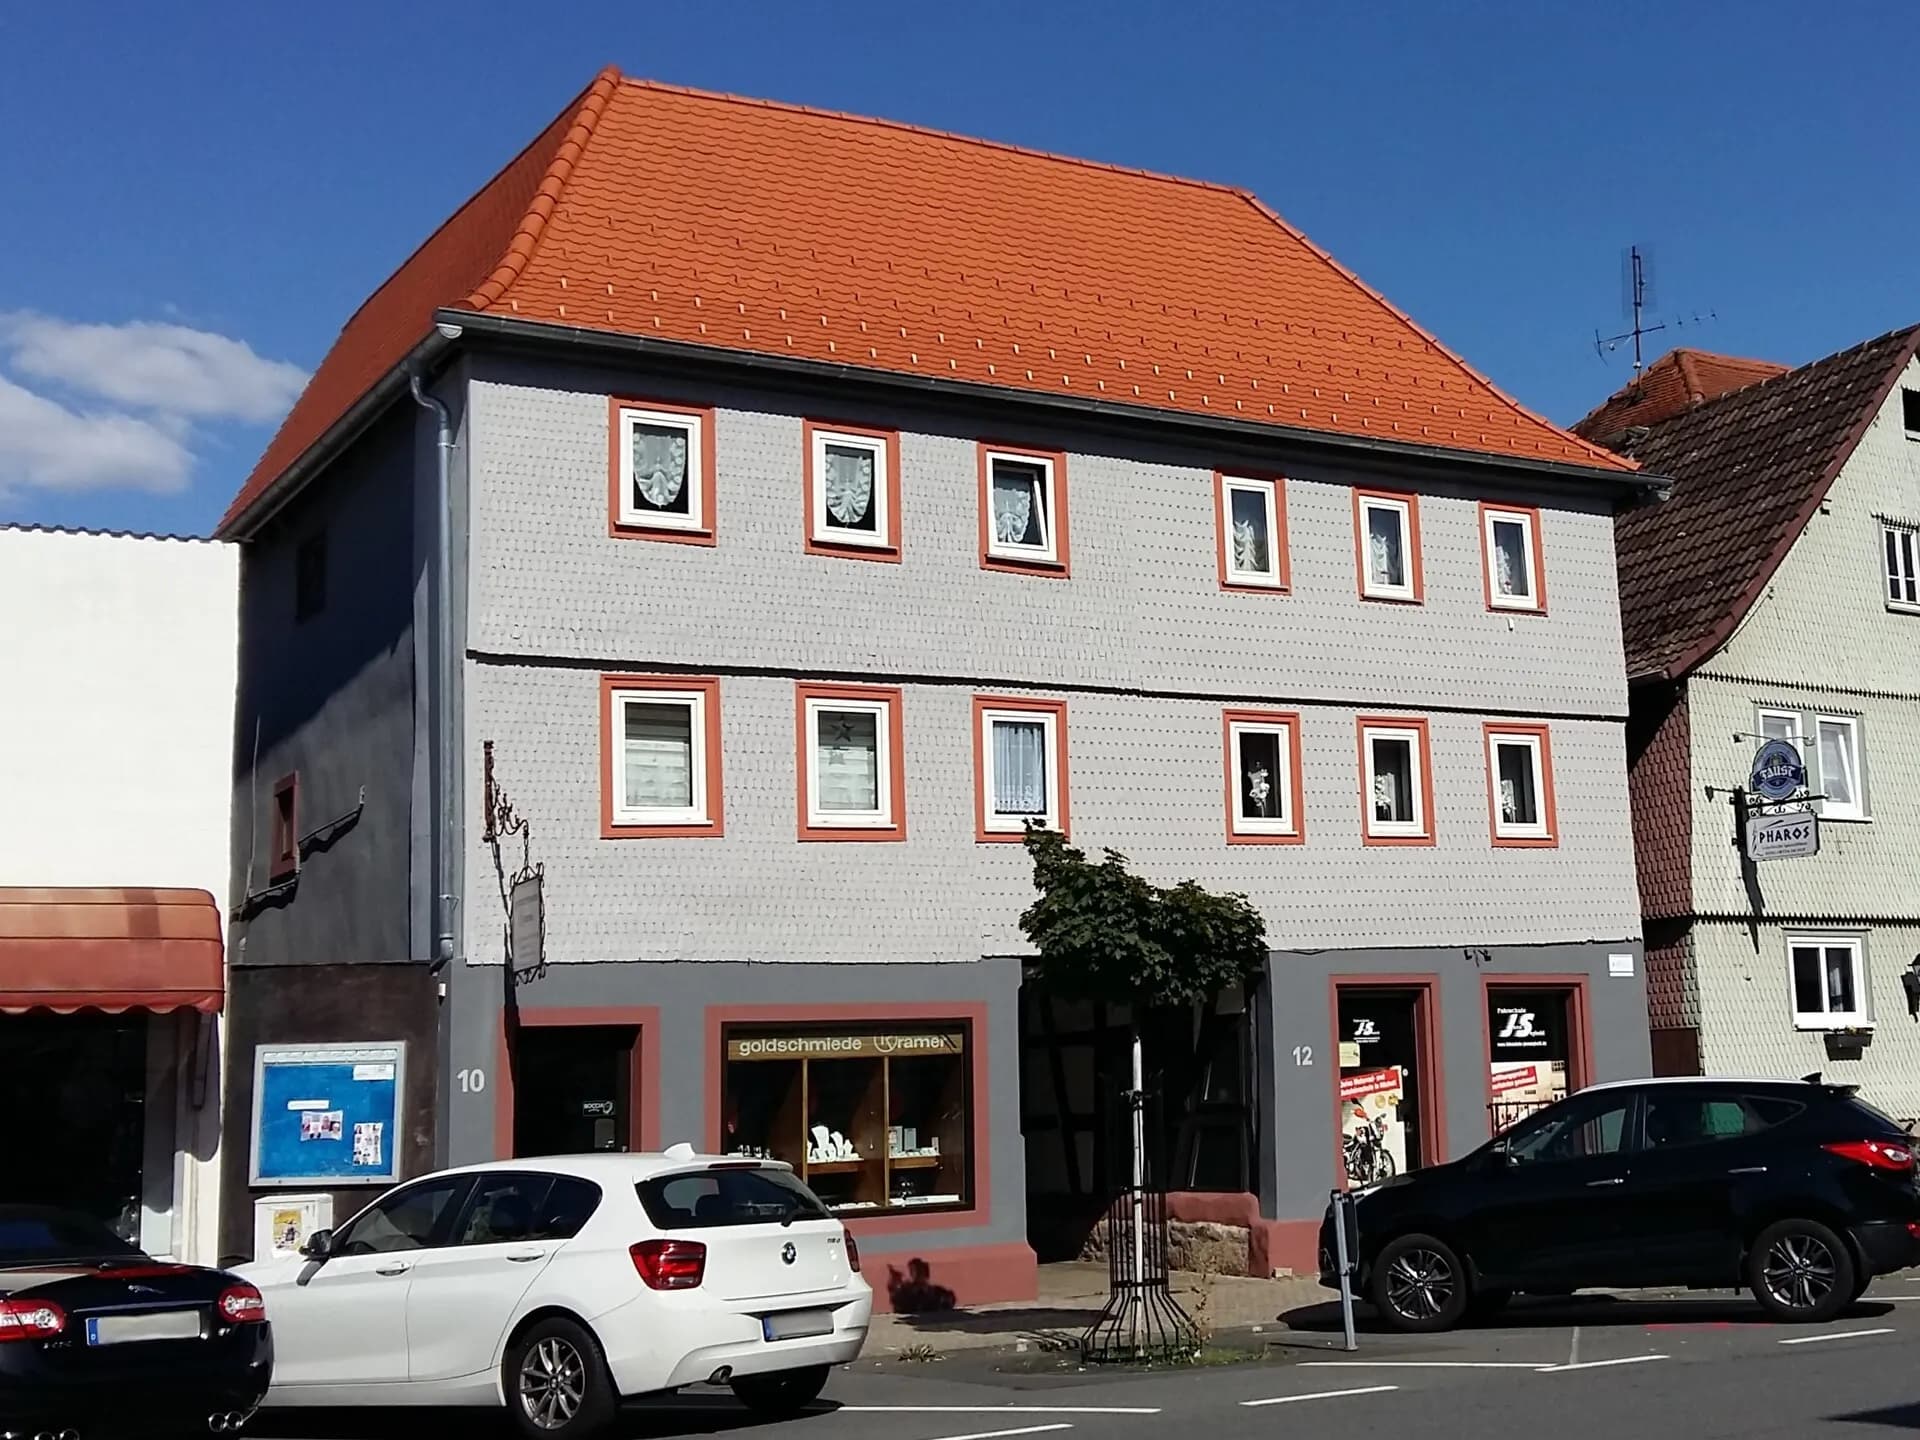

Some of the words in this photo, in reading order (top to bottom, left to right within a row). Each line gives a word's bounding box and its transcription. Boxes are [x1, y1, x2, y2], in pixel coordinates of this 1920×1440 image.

[1760, 765, 1796, 780] FAUST
[1759, 826, 1809, 843] PHAROS
[739, 1037, 862, 1056] goldschmiede
[1292, 1046, 1313, 1066] 12
[457, 1068, 485, 1092] 10
